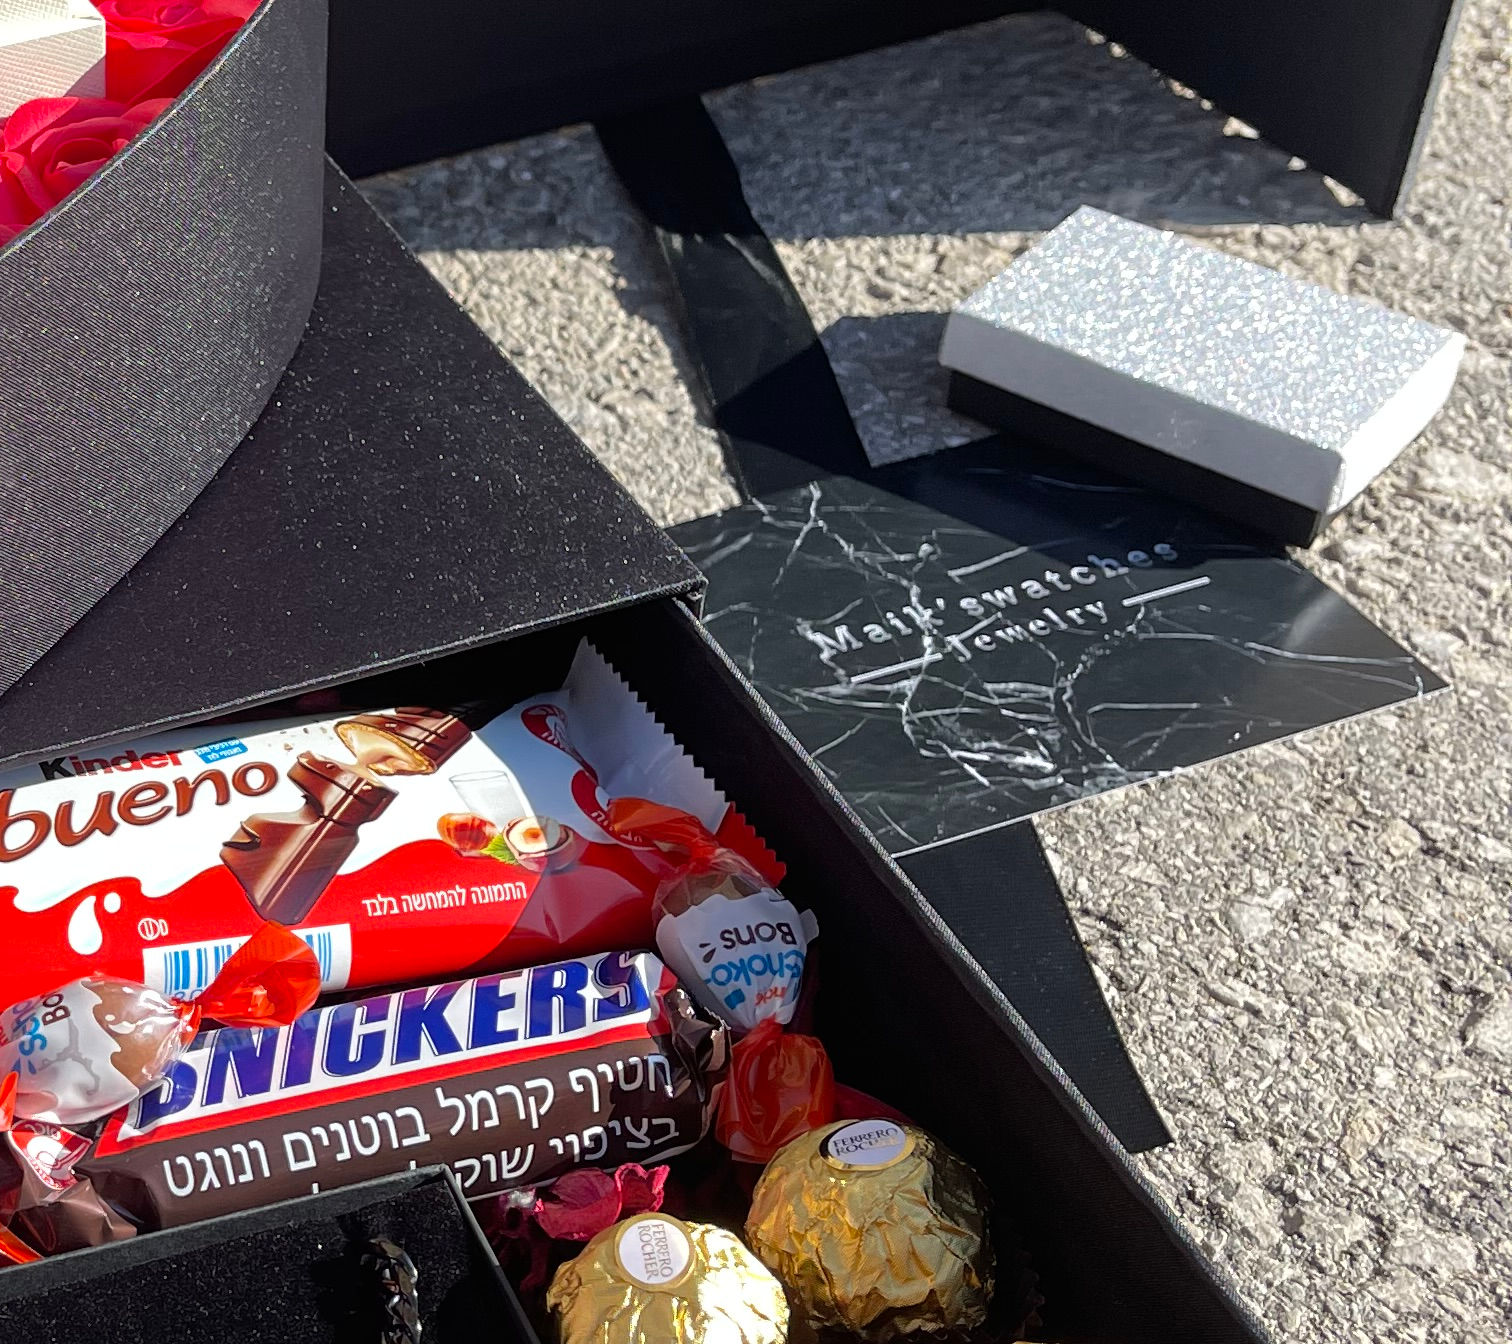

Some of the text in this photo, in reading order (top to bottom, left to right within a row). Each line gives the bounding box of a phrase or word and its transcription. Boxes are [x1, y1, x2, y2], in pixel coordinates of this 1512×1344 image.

[37, 749, 183, 781] Kinder
[362, 881, 528, 918] התמונה להמחשה בלבד
[719, 921, 798, 951] Bons
[133, 950, 650, 1131] SNICKERS
[162, 1054, 672, 1199] חטיף קרמל בוטנים ונוגט
[549, 1115, 680, 1164] בציפוי
[832, 1127, 899, 1148] FERRERO
[636, 1223, 661, 1282] ROCHER
[650, 1222, 675, 1279] FERRERO
